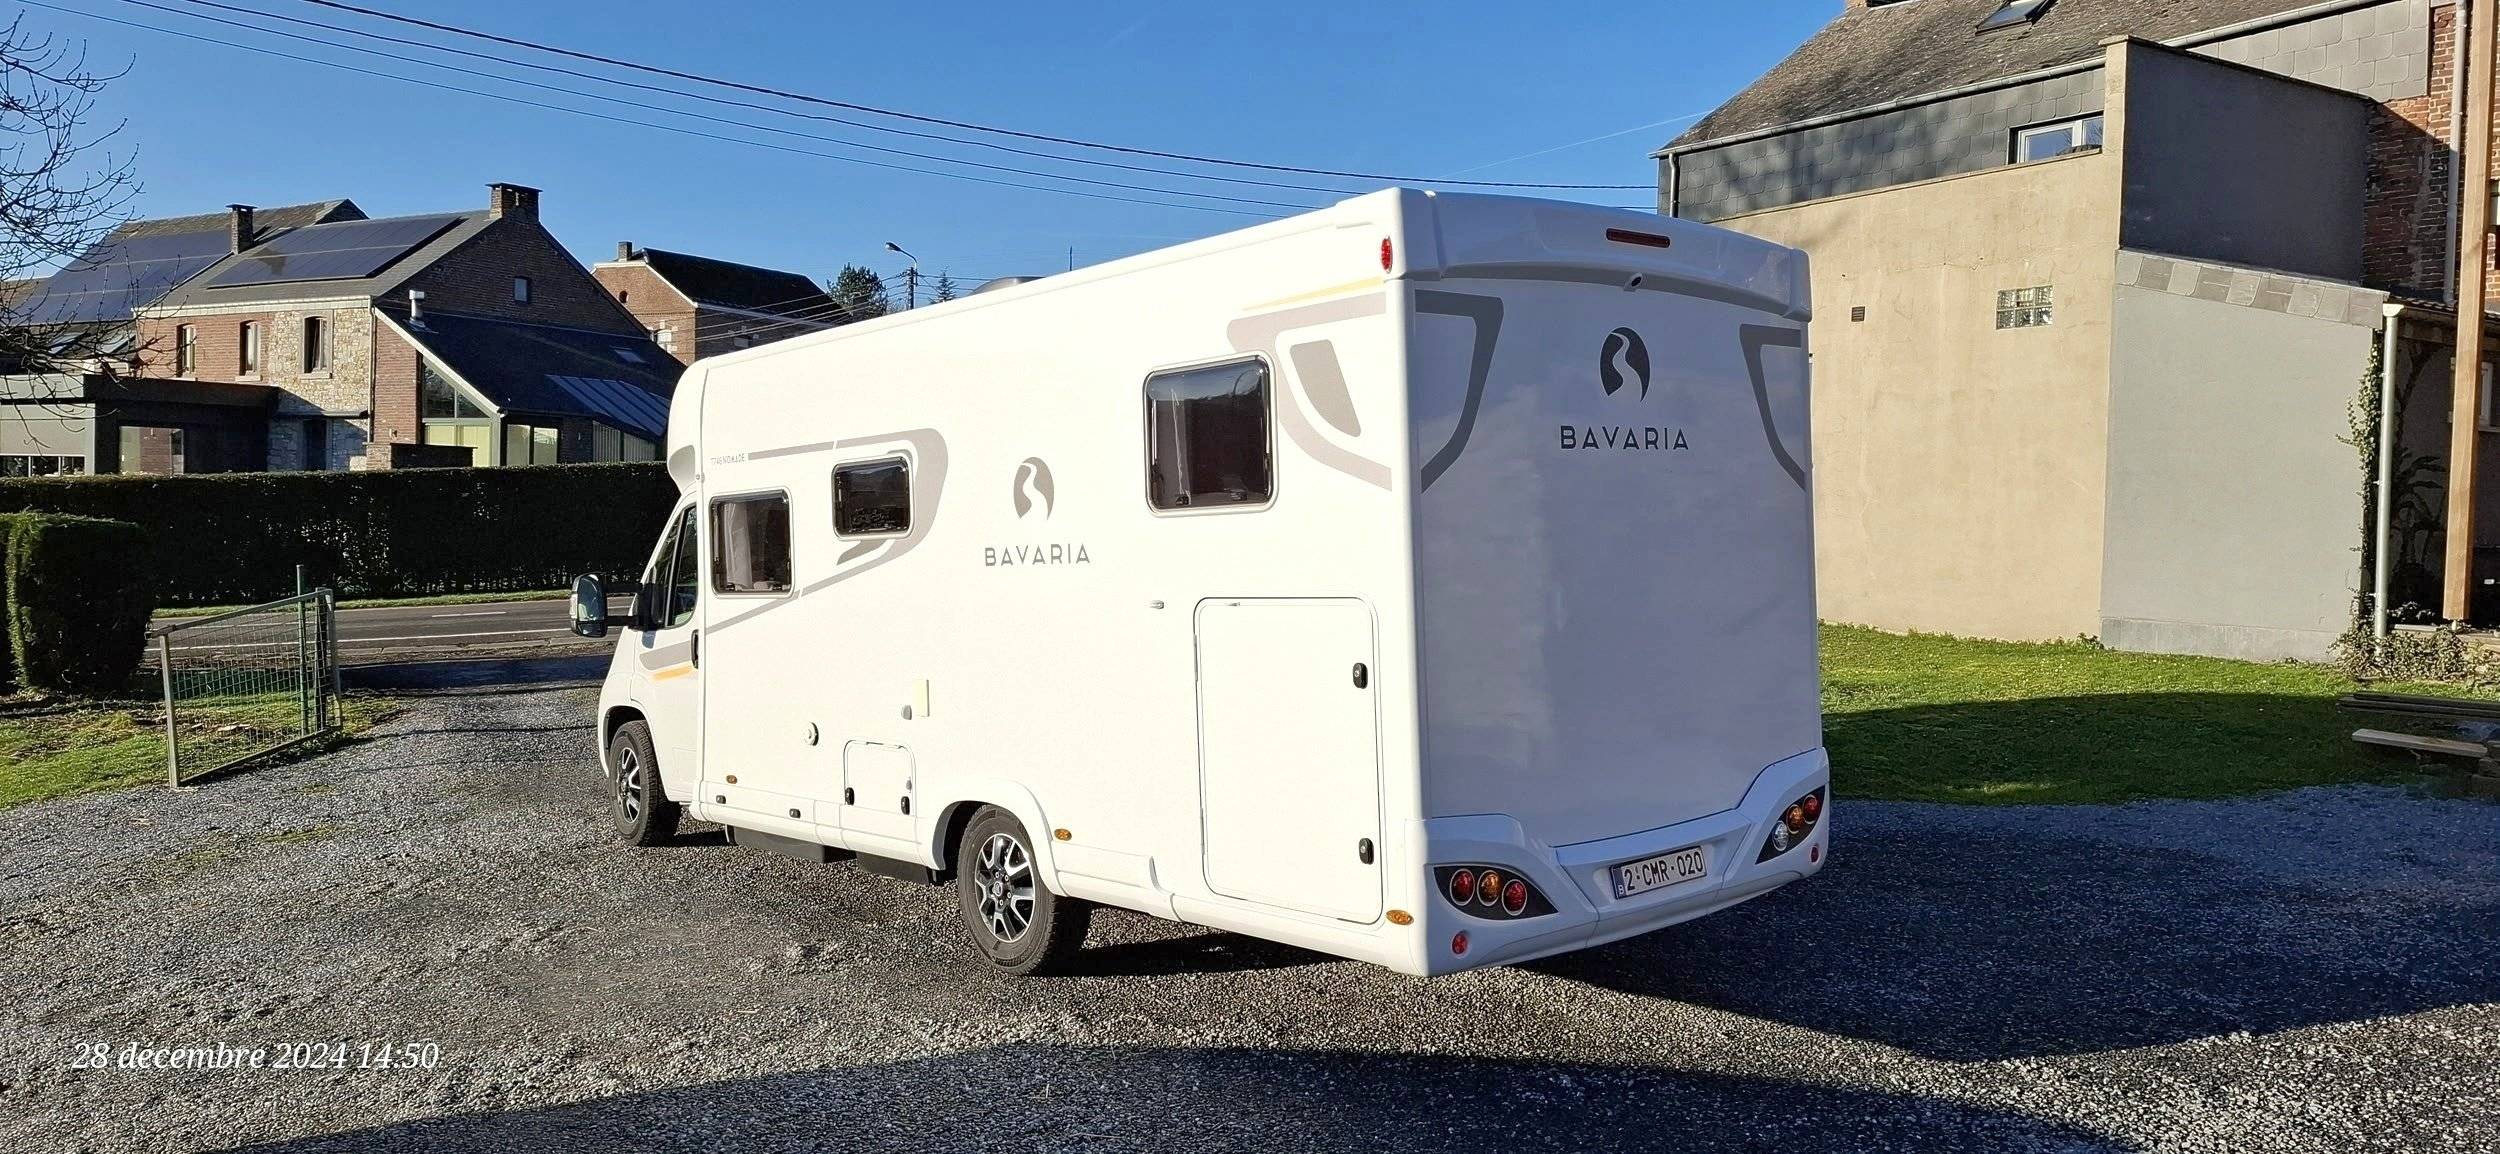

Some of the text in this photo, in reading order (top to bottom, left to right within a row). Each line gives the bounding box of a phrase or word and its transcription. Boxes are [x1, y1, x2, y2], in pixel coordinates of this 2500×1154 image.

[1560, 425, 1689, 450] BAVARIA
[984, 543, 1091, 567] BAVARIA
[1617, 884, 1625, 895] B
